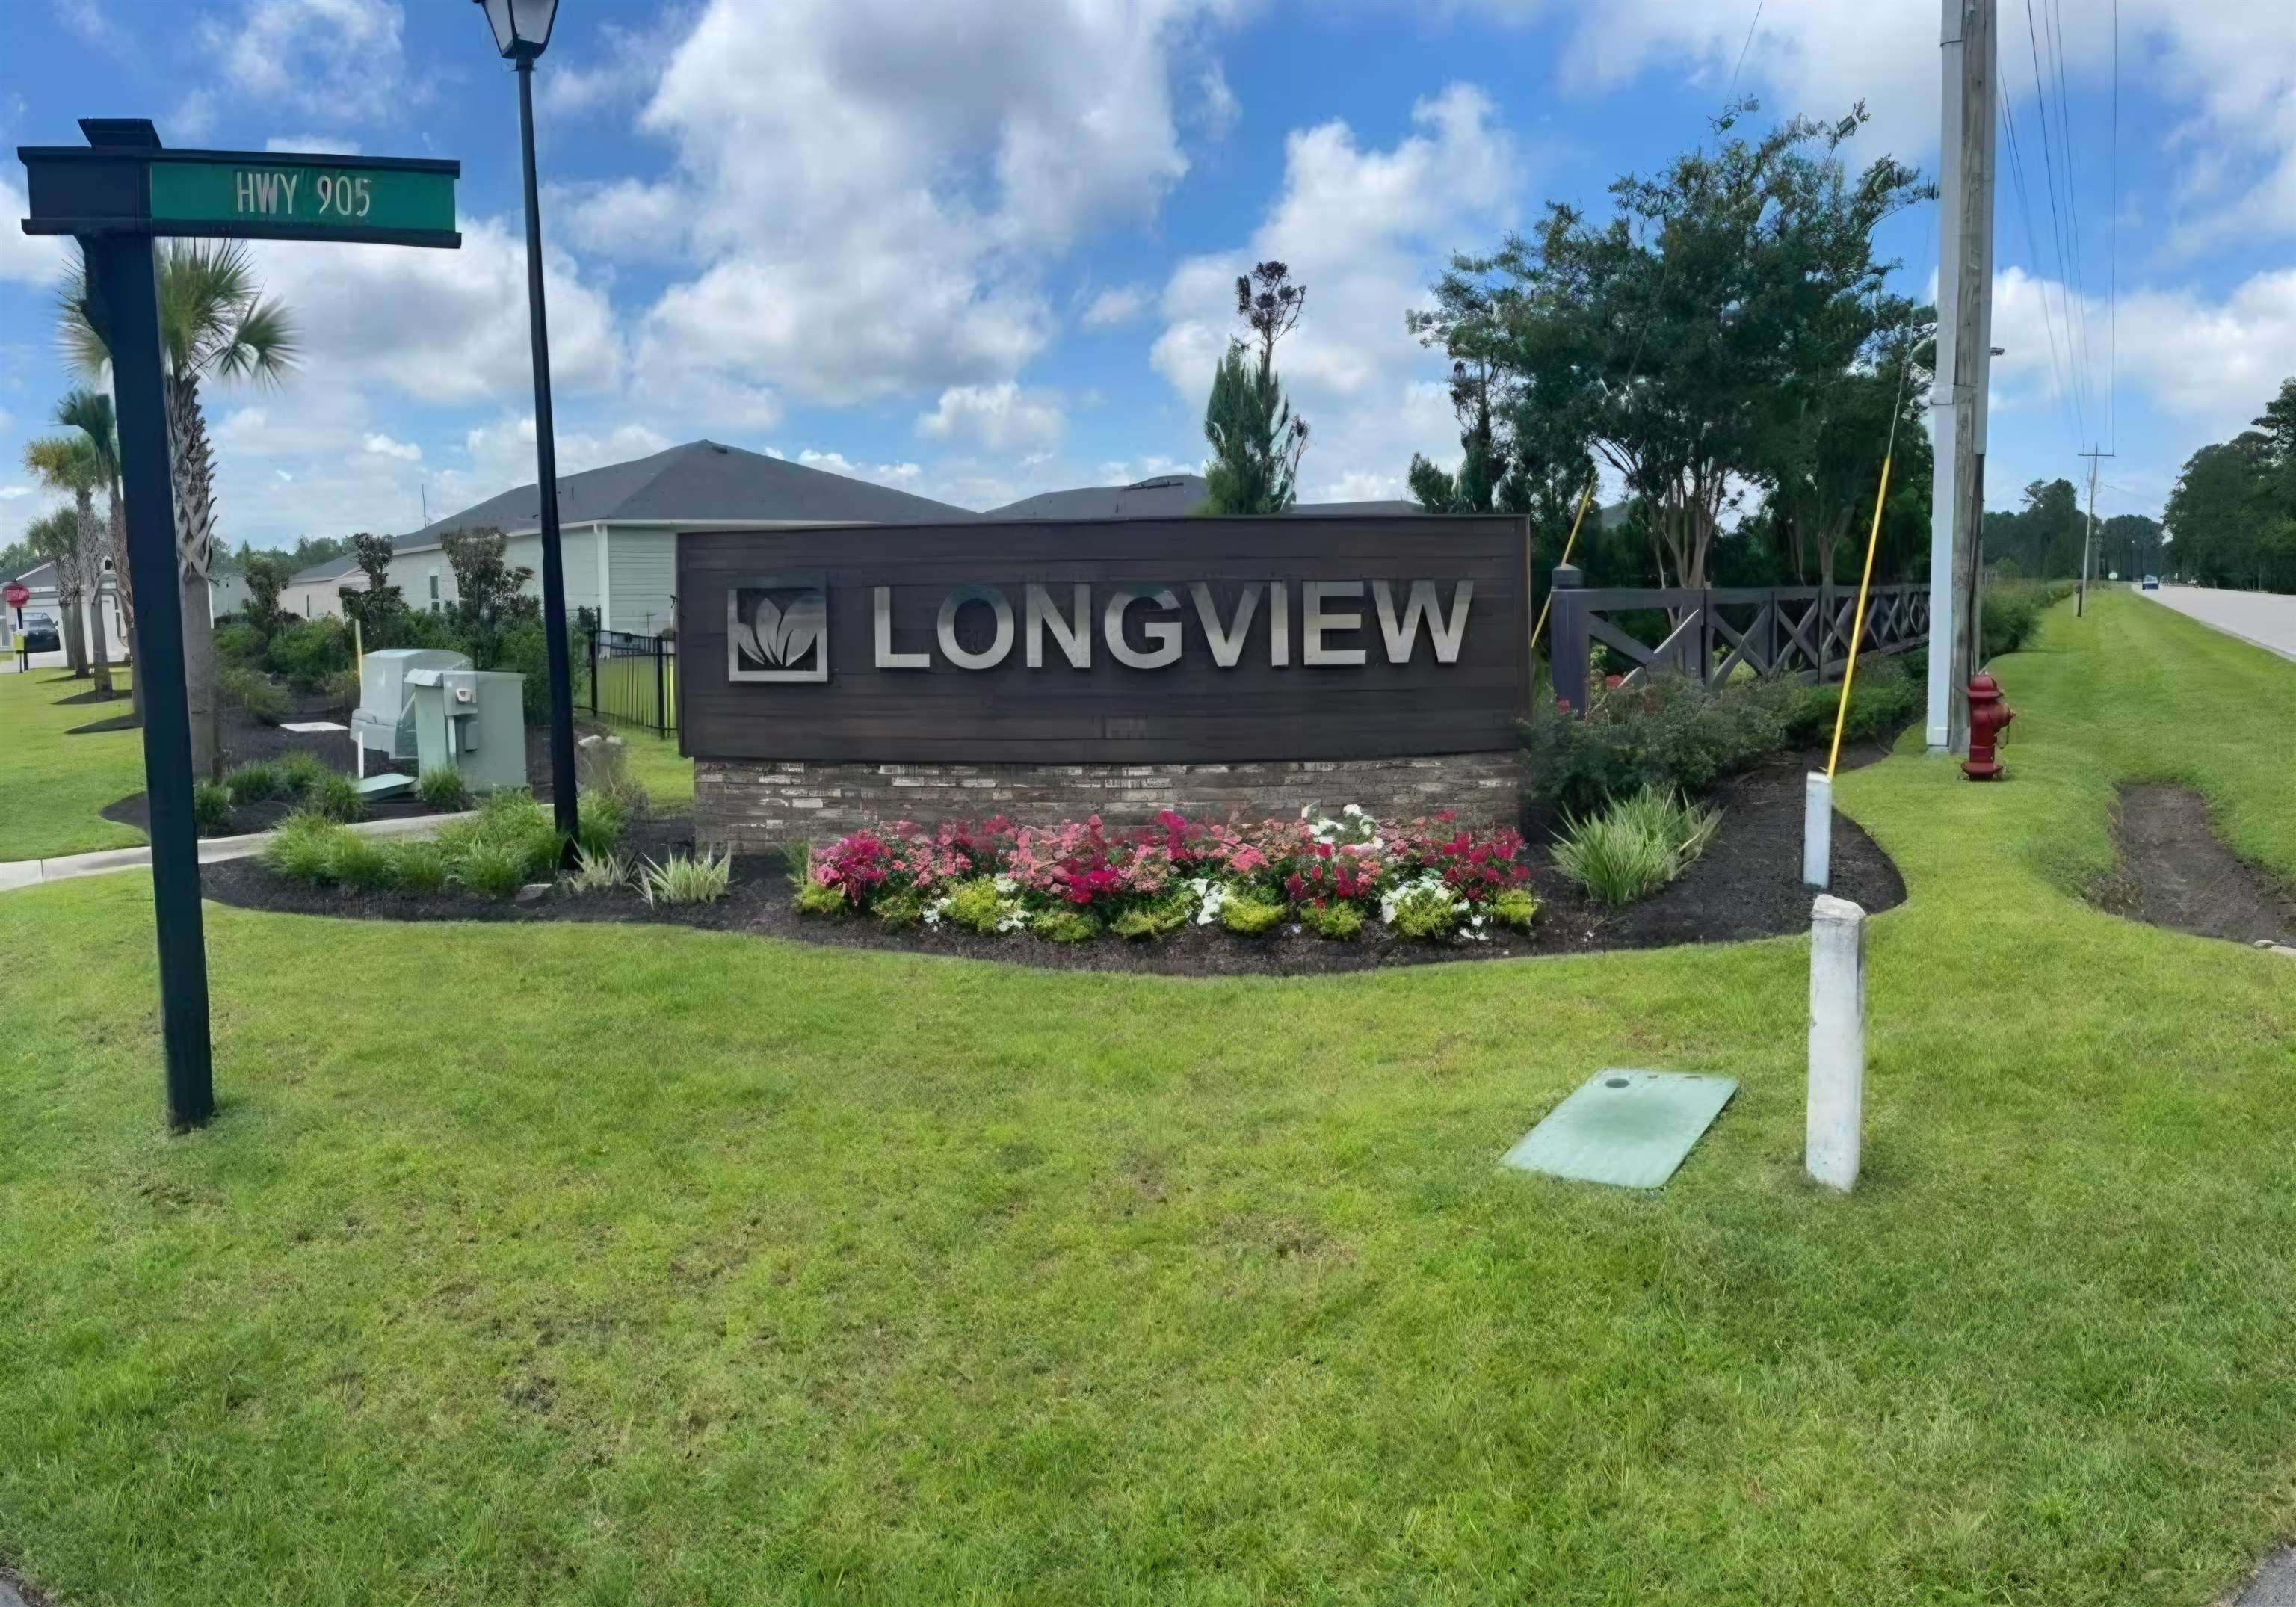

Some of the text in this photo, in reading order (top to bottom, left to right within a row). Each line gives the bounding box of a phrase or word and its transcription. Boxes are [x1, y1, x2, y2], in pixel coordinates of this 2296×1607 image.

[237, 172, 371, 217] HWY 905
[873, 579, 1475, 670] LONGVIEW
